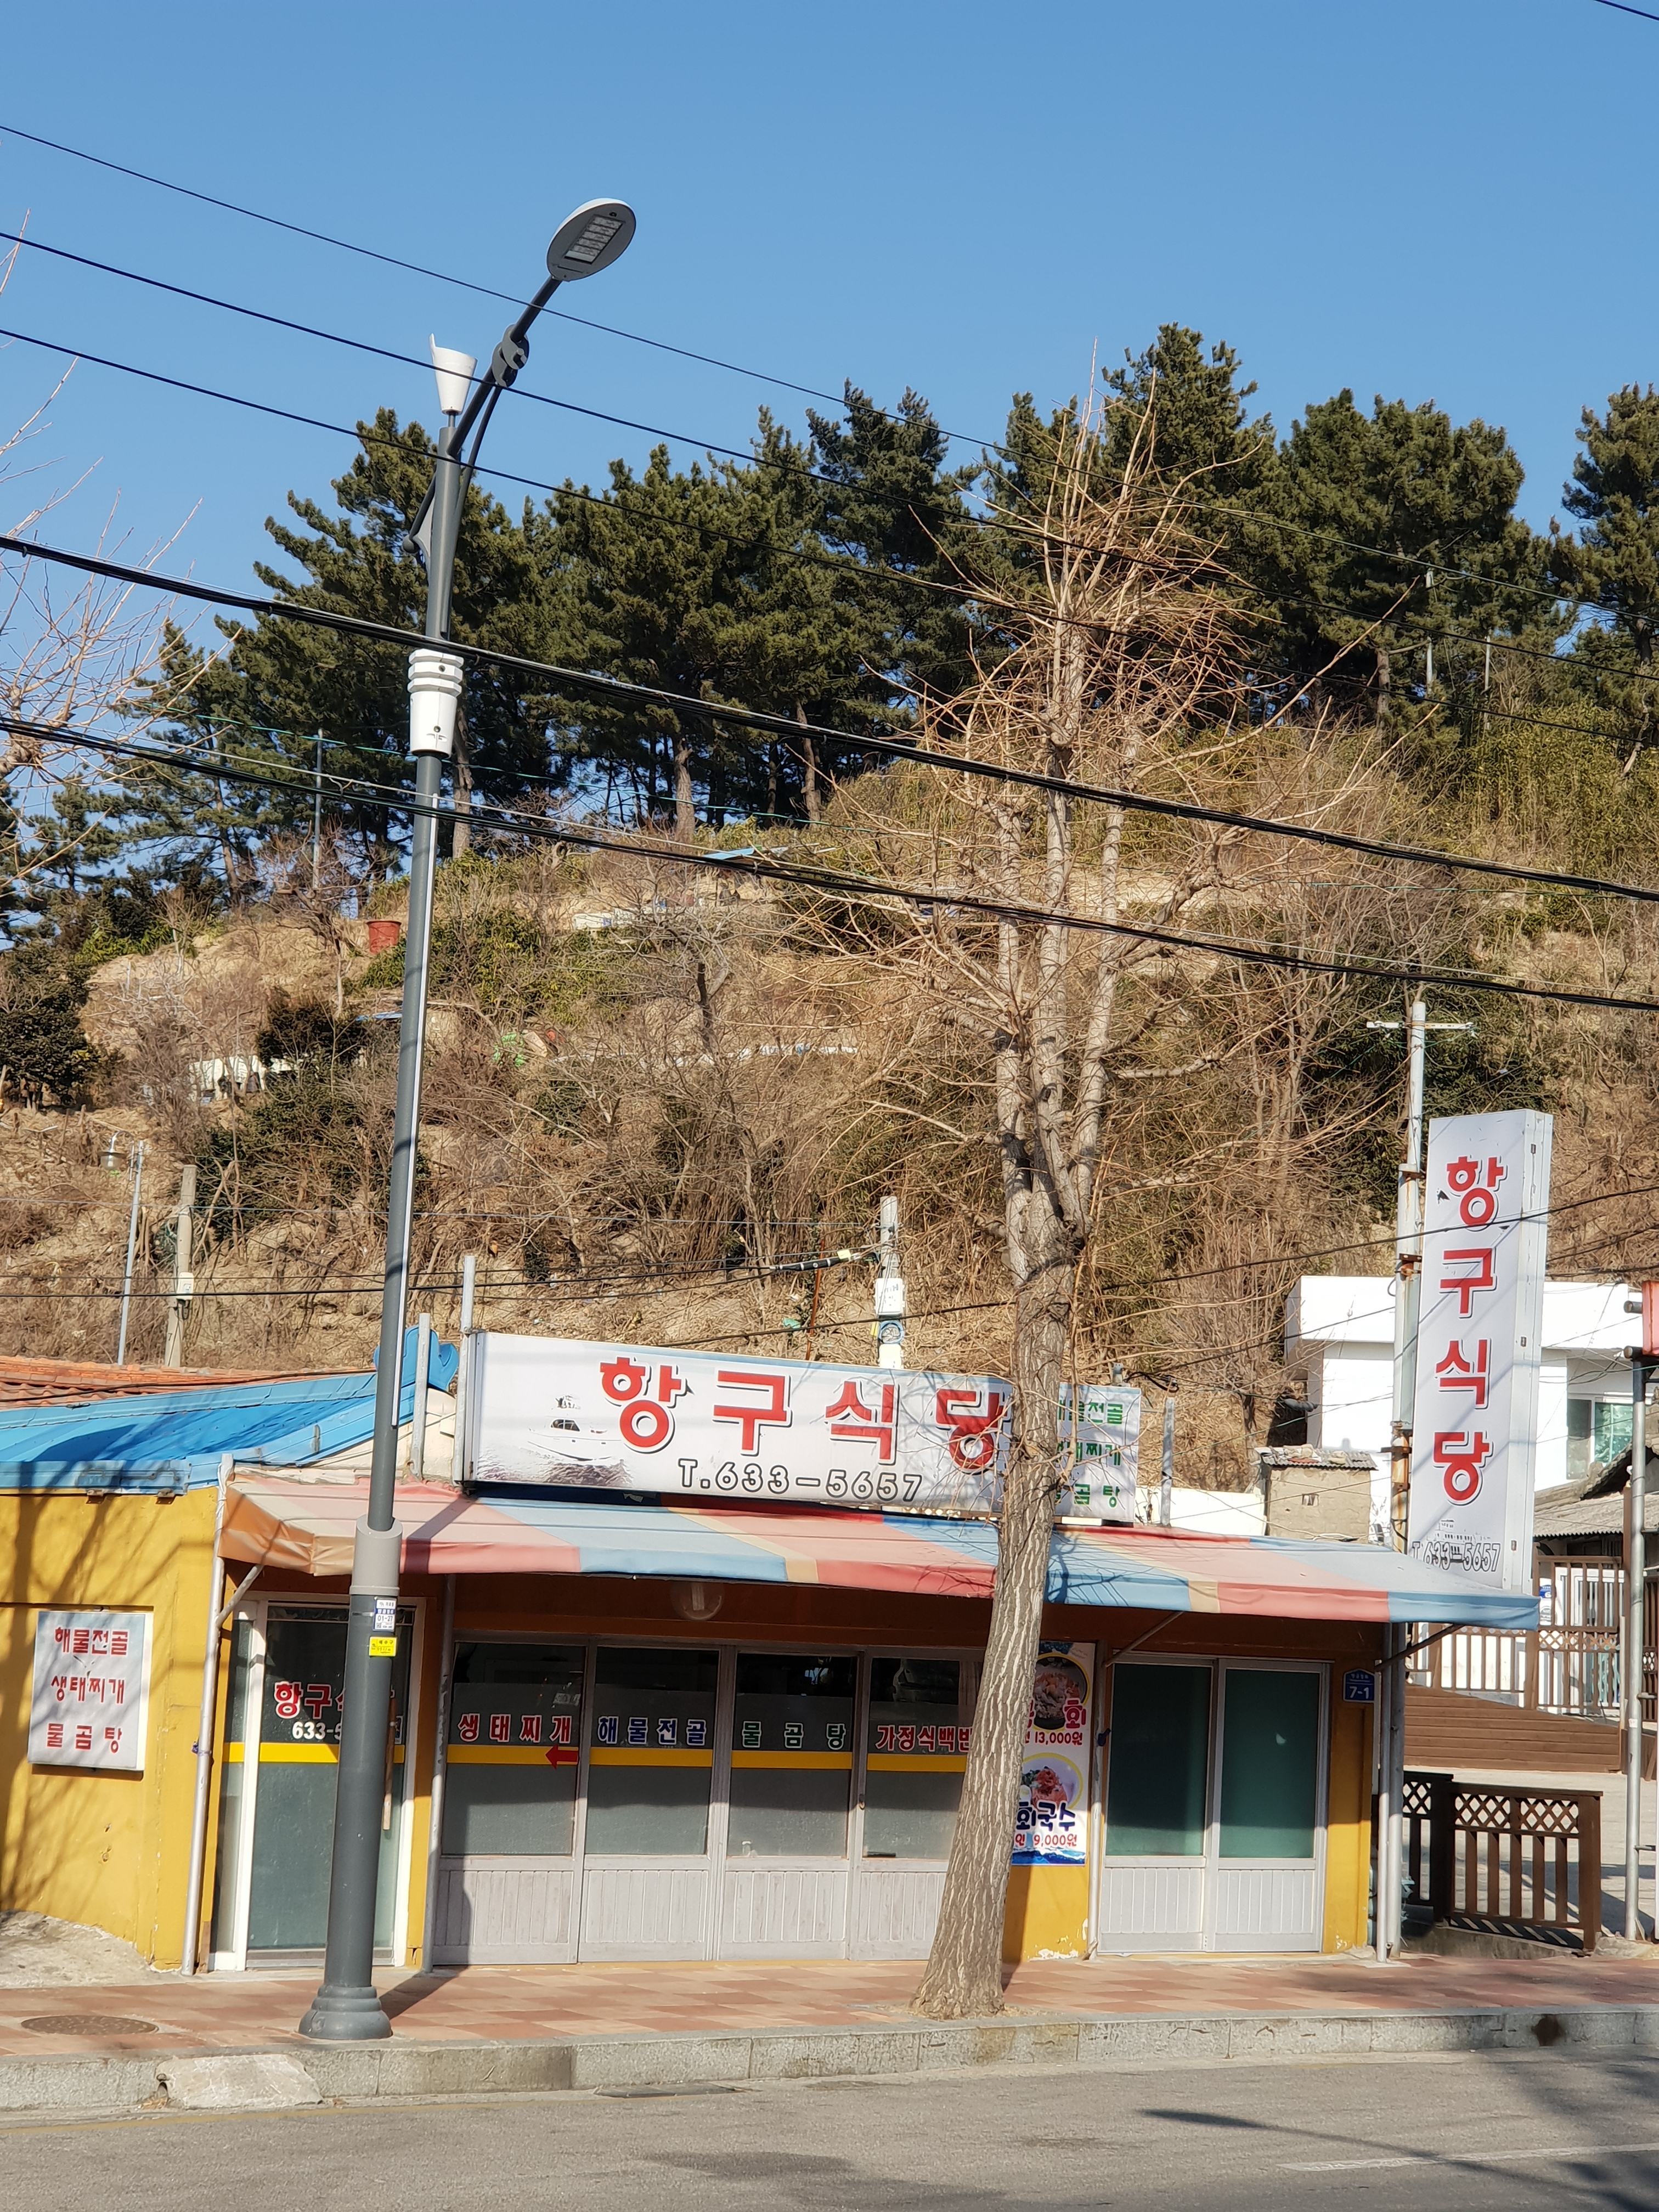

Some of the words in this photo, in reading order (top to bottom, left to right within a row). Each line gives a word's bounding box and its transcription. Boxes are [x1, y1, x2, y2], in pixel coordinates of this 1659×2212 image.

[1434, 1155, 1508, 1505] 항구식당
[600, 1357, 1010, 1473] 항구식당
[679, 1459, 922, 1502] T.633-5657
[54, 1627, 128, 1656] 해물전골
[51, 1675, 125, 1704] 생태찌개
[1350, 1686, 1369, 1699] 7-1
[458, 1713, 572, 1743] 생태찌개
[597, 1716, 707, 1746] 해물전골
[1035, 1731, 1082, 1745] 13,000원
[1016, 1801, 1076, 1831] 회국수
[1034, 1833, 1077, 1847] 9,000원
